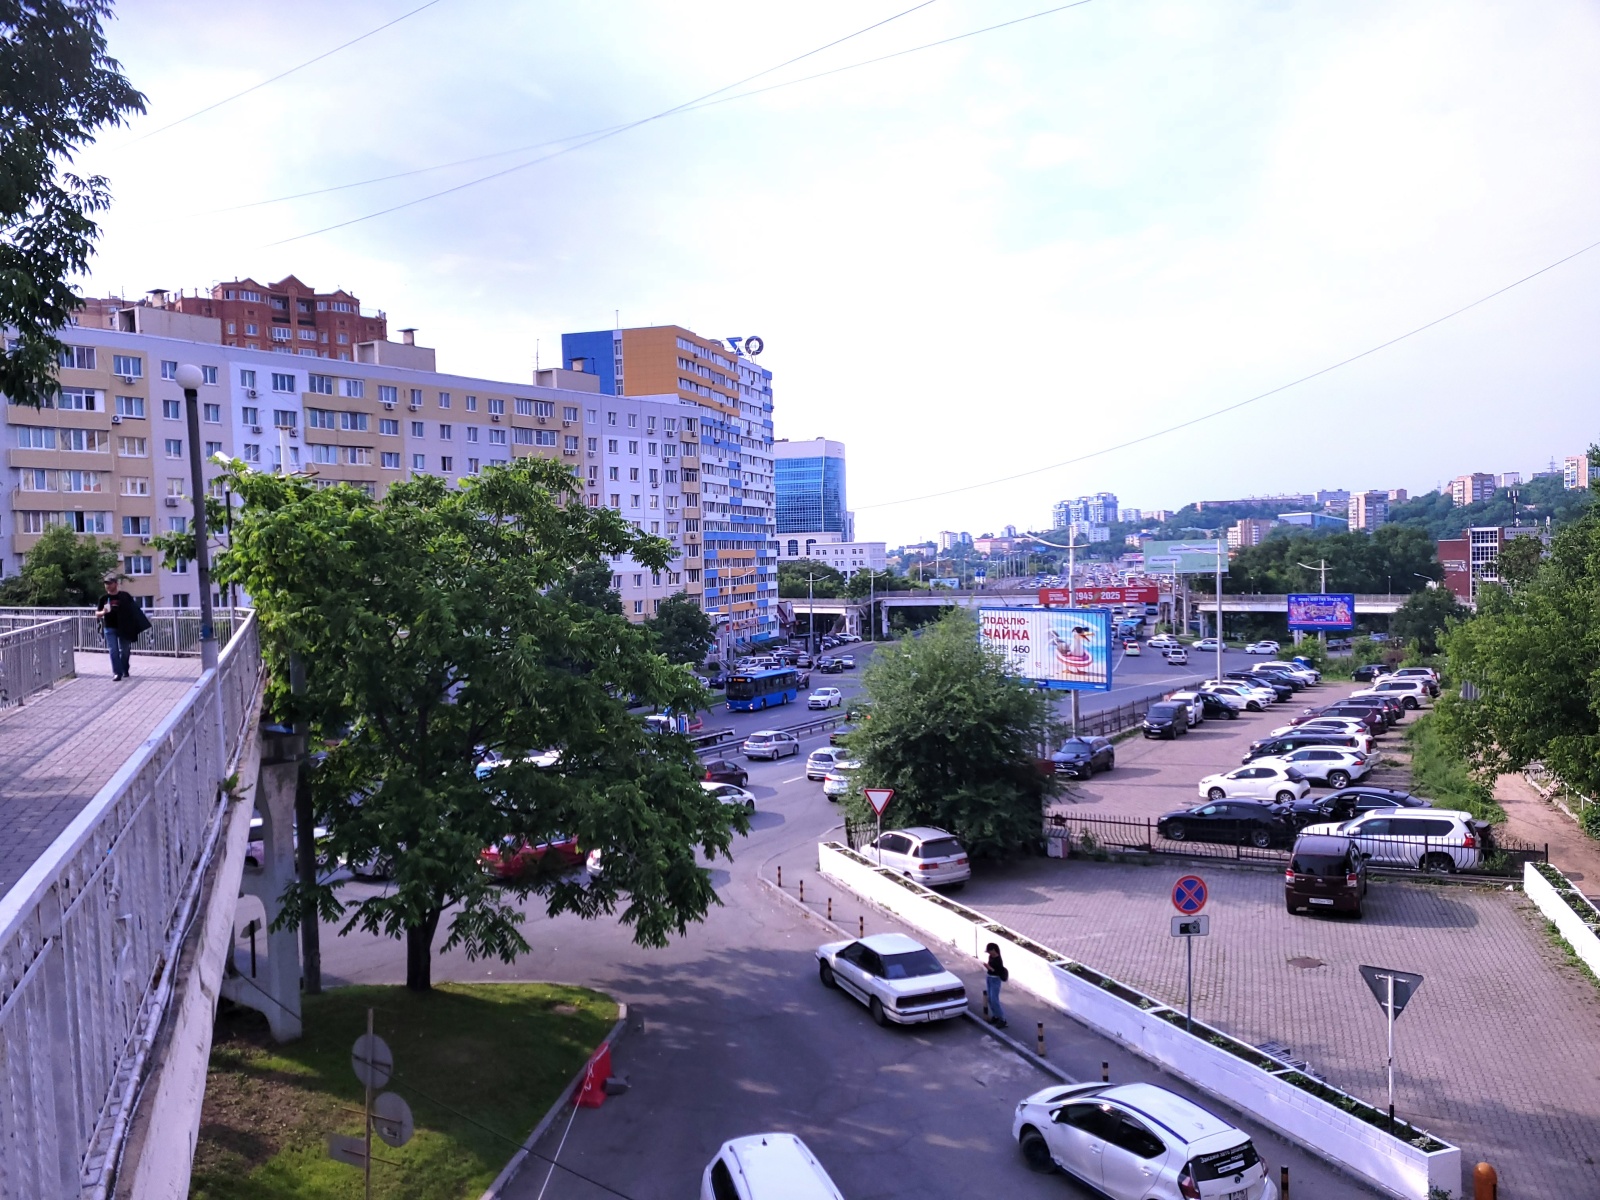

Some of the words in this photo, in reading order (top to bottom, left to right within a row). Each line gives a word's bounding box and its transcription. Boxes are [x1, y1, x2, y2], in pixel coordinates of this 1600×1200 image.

[1100, 591, 1121, 600] 2025
[983, 626, 1030, 641] ЧАЙКА
[1012, 645, 1030, 654] 460
